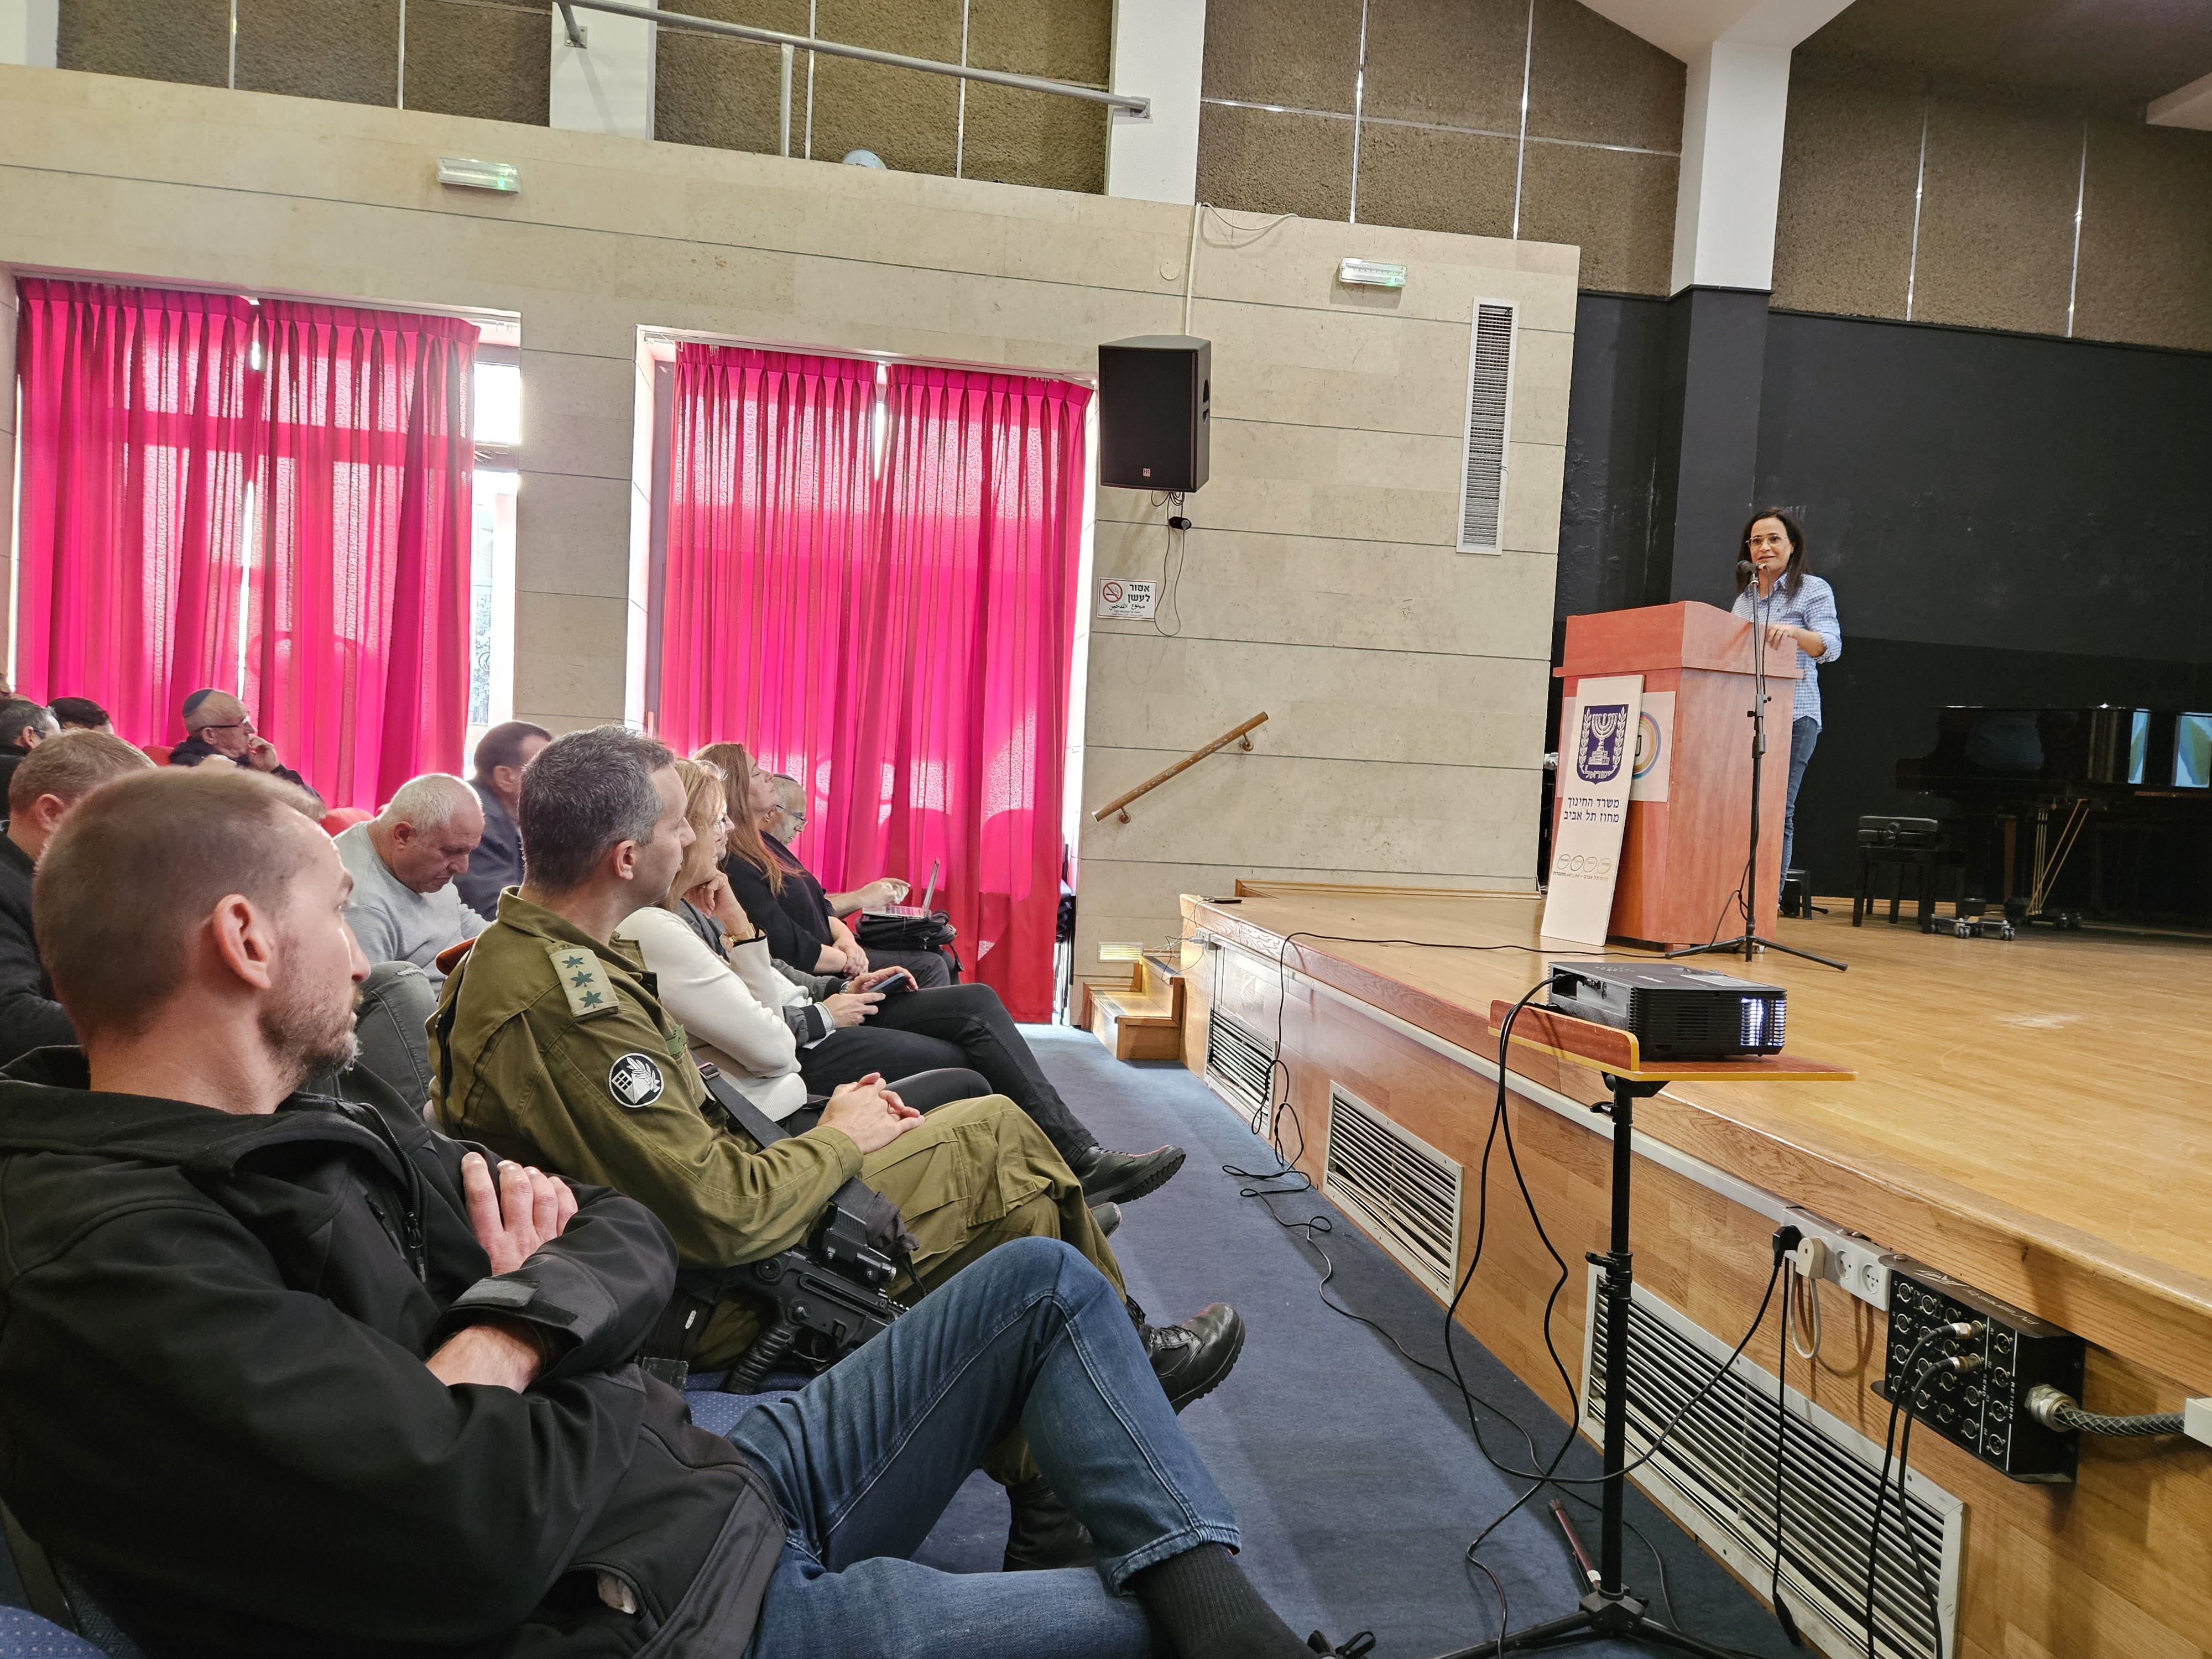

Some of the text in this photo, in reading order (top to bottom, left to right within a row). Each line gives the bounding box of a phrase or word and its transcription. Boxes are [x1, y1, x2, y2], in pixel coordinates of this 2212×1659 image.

[1129, 584, 1150, 592] אסור
[1128, 594, 1150, 603] לעשן
[1585, 765, 1612, 779] ישראל
[1568, 797, 1619, 808] משרד החינוך
[1563, 809, 1619, 823] מחוז תל אביב
